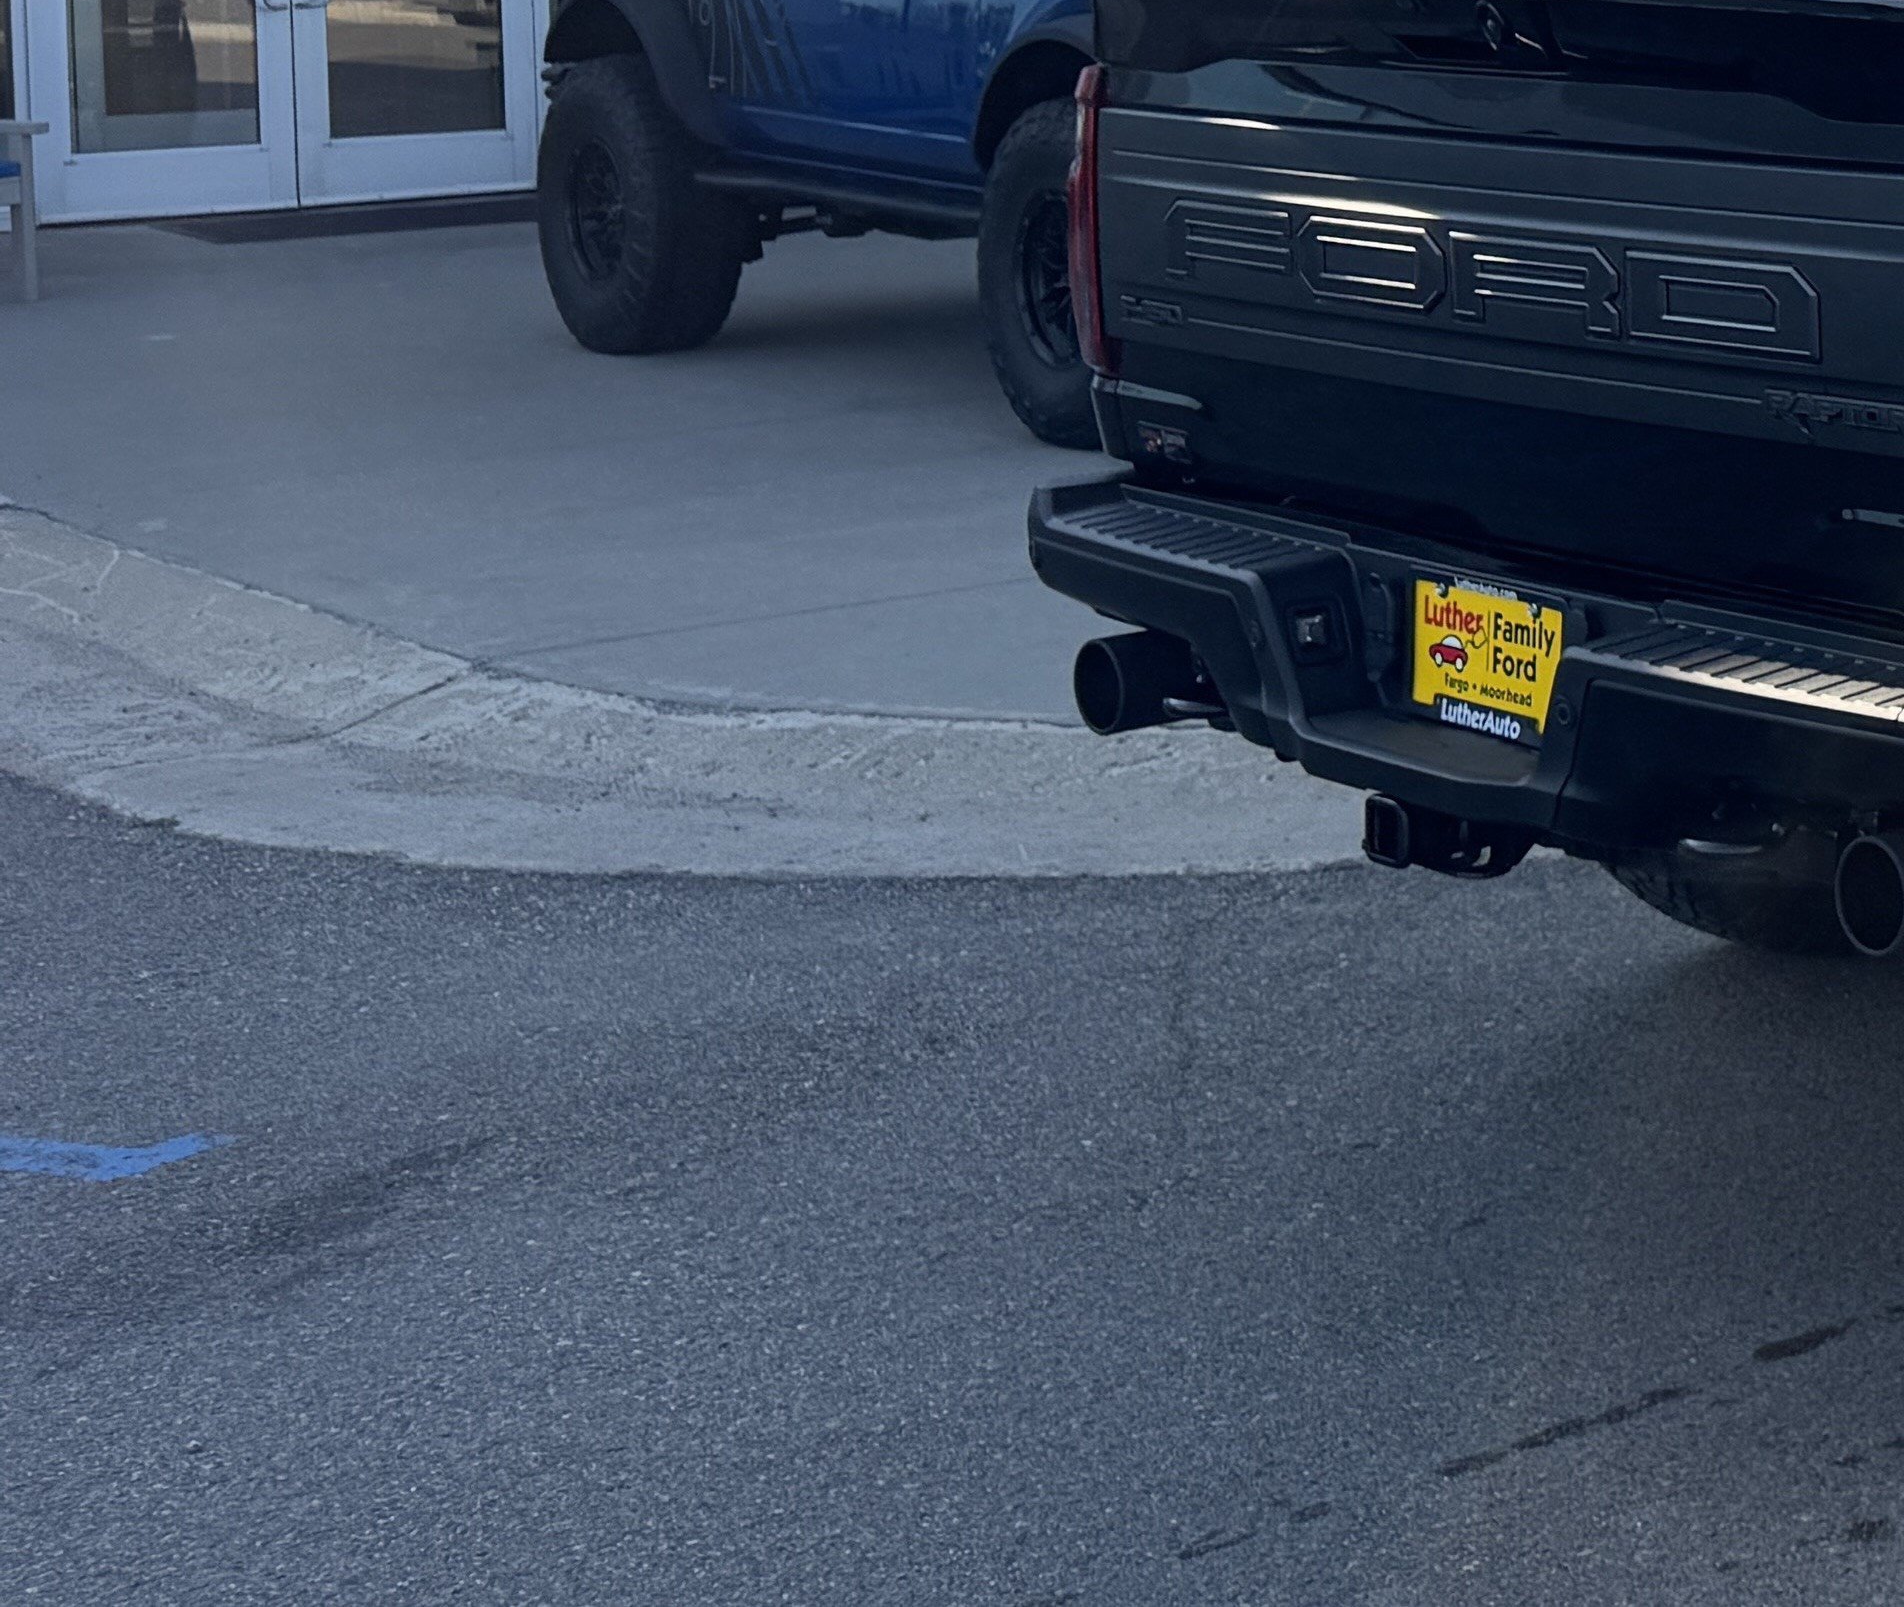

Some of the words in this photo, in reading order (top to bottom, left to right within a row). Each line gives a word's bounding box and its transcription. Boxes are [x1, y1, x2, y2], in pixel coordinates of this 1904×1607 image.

[1164, 198, 1822, 365] FORD
[1424, 594, 1483, 635] Luther
[1493, 611, 1556, 658] Family
[1492, 646, 1537, 682] Ford
[1444, 672, 1469, 694] Fargo
[1480, 679, 1533, 708] Moorhead
[1440, 697, 1521, 740] LutherAuto
